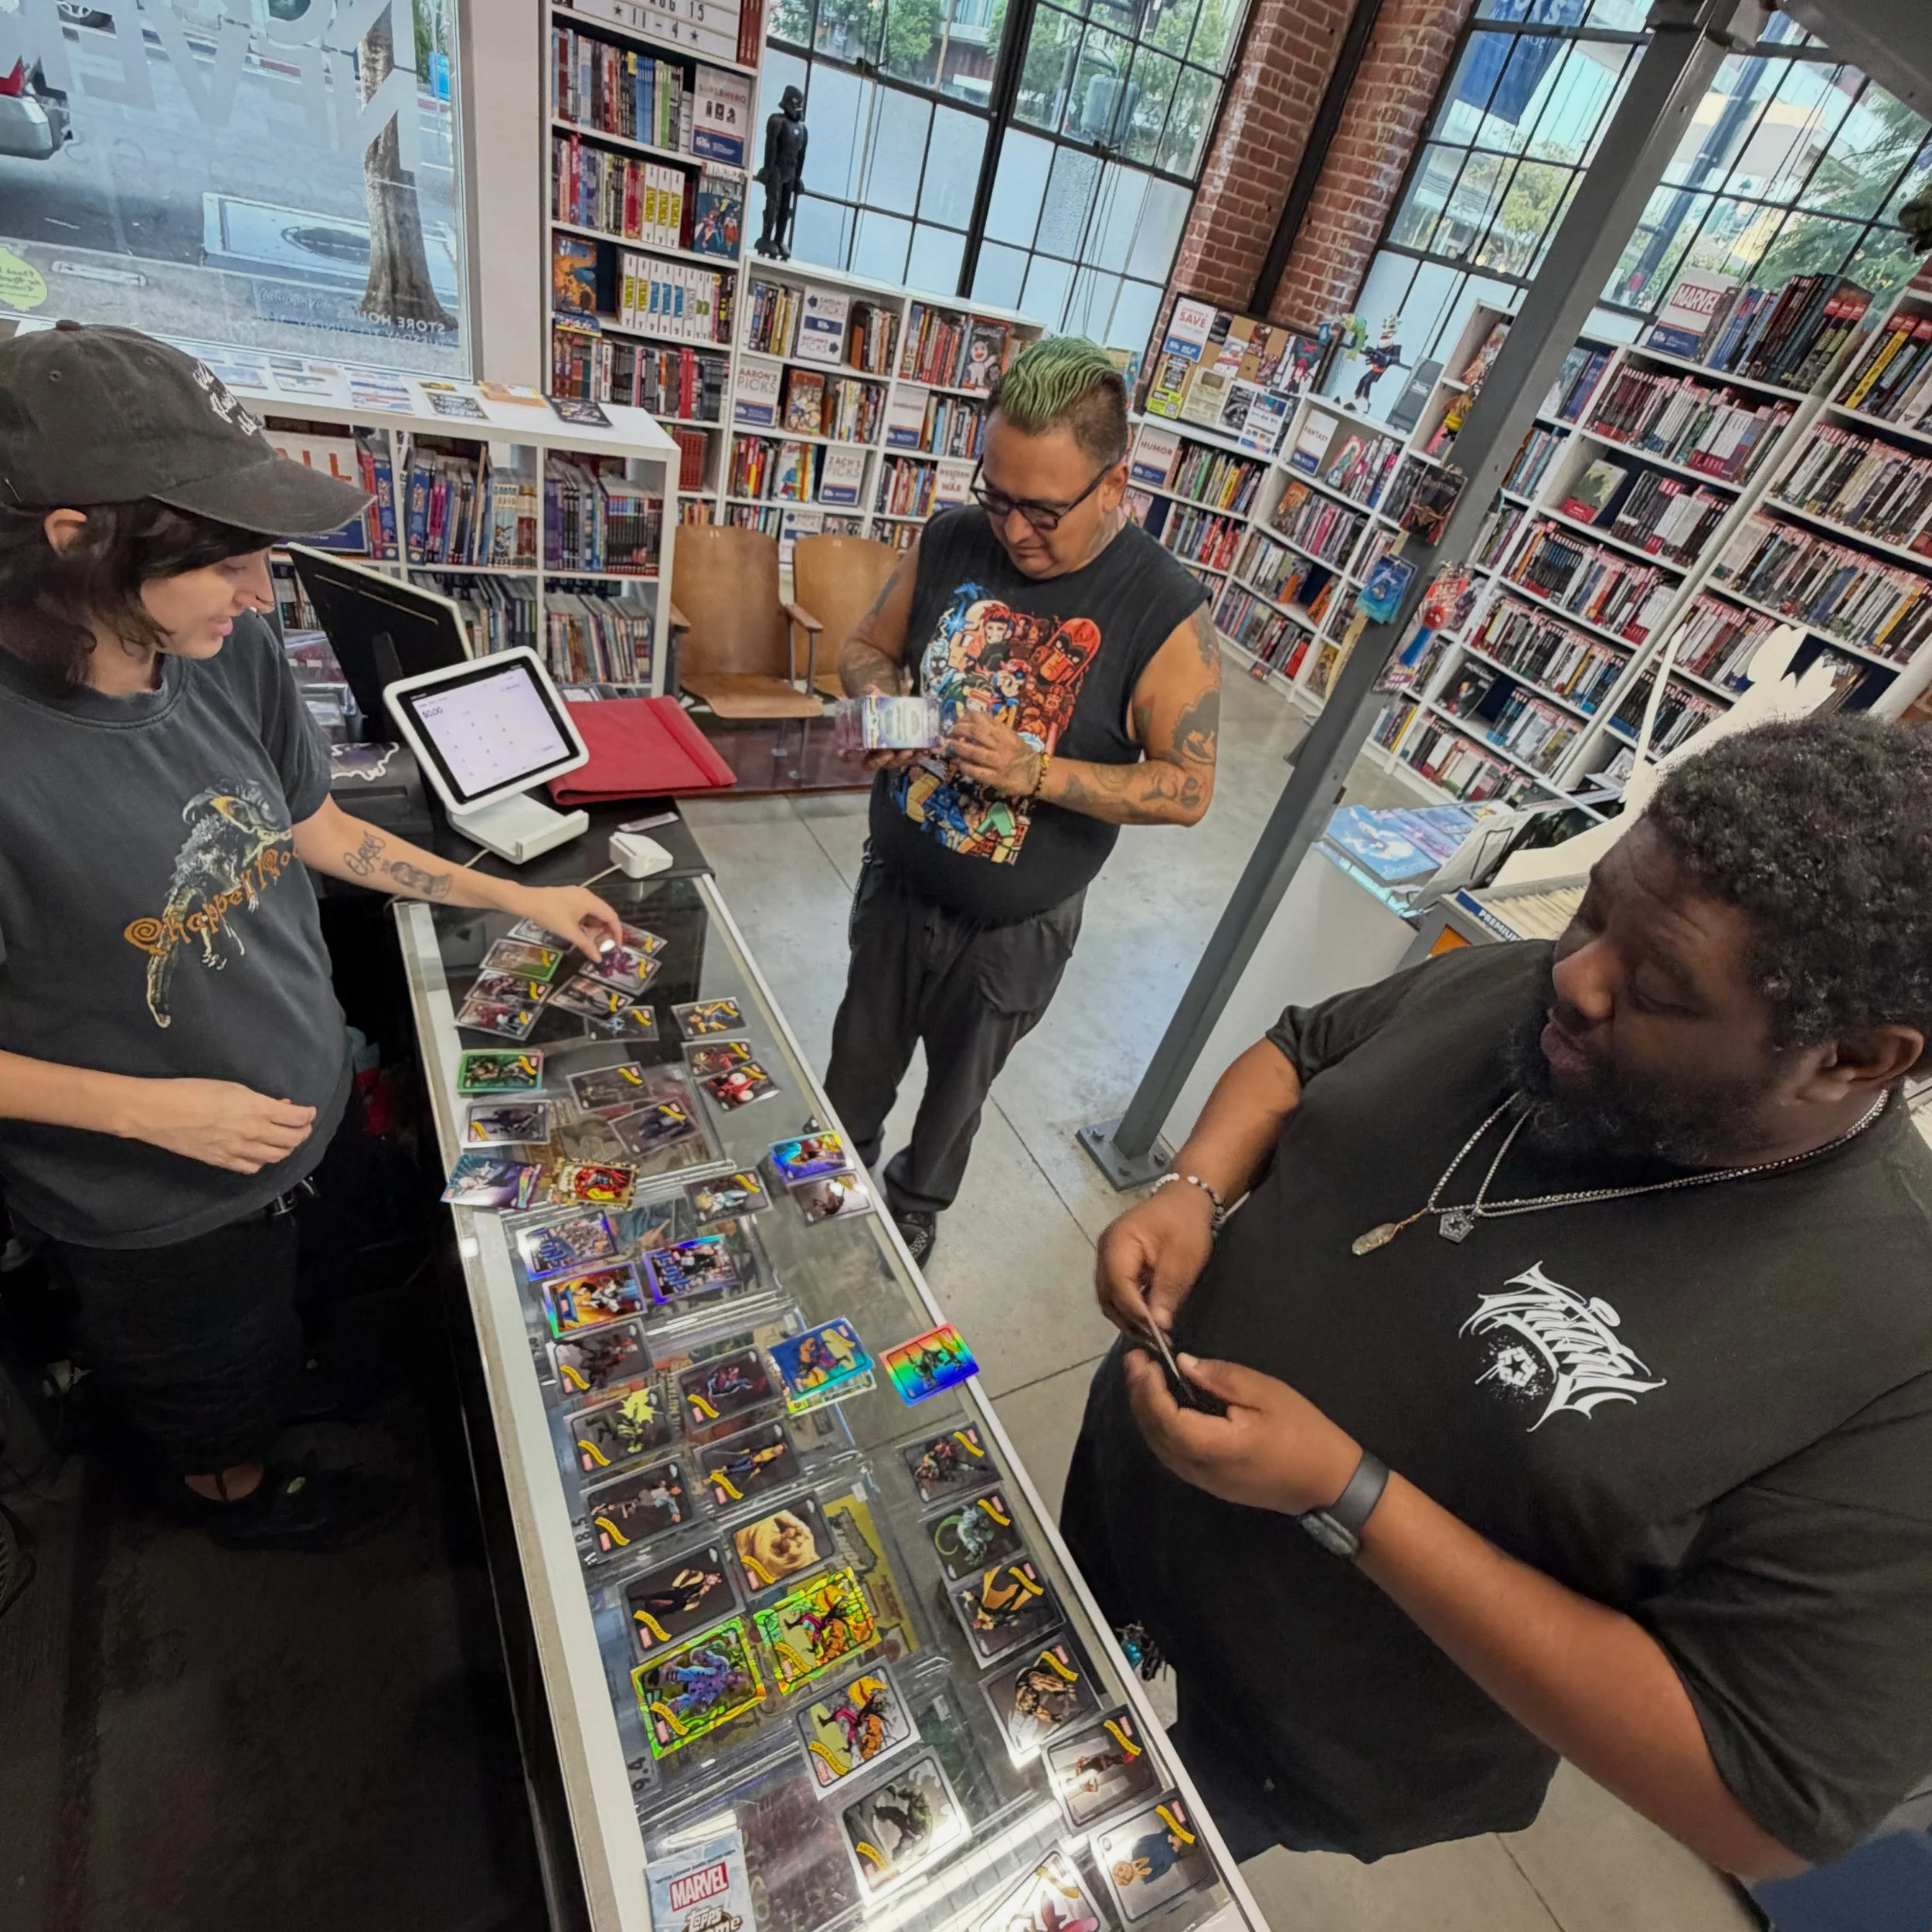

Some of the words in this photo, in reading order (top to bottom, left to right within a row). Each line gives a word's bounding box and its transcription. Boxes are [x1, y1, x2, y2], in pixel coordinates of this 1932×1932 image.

[650, 0, 675, 12] UG
[689, 2, 705, 22] 15
[632, 7, 646, 28] 11
[672, 22, 679, 39] 4
[1179, 311, 1208, 328] SAVE
[737, 376, 777, 395] PICKS
[1141, 440, 1173, 456] HUMOR
[826, 466, 860, 478] PICKS
[571, 1515, 592, 1543] 8.5
[628, 1756, 651, 1791] 9.4
[671, 1863, 728, 1910] MARVEL
